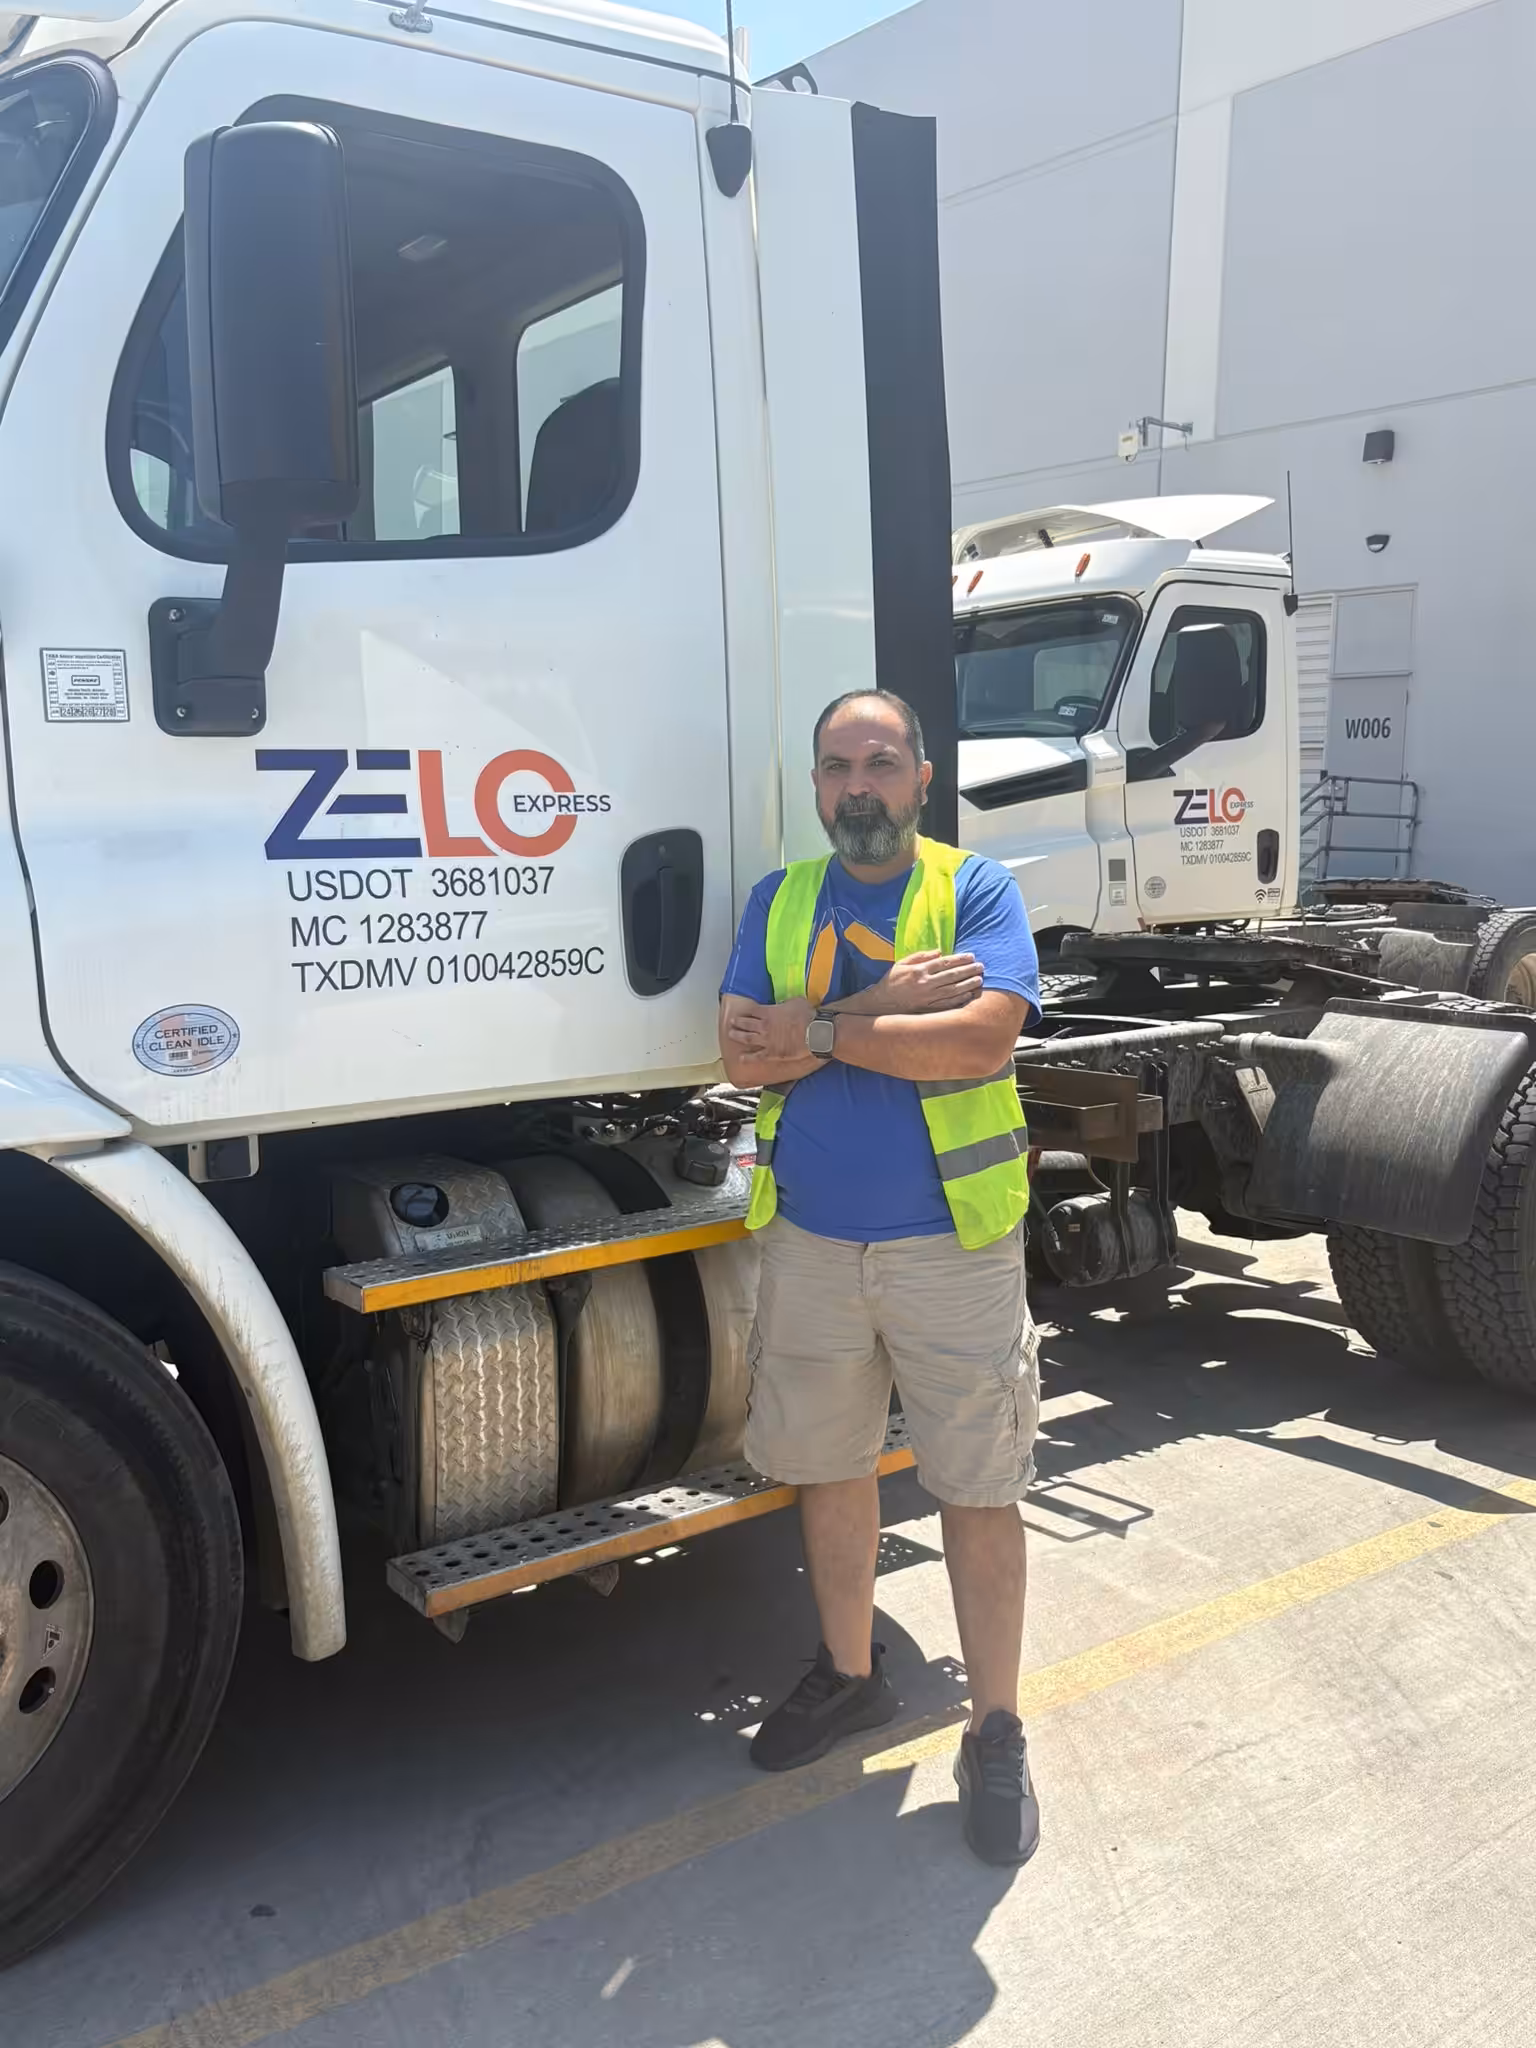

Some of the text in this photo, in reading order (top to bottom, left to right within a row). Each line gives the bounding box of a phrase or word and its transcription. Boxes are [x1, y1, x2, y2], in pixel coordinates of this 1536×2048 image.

[1345, 717, 1391, 739] W006
[513, 795, 611, 813] EXPRESS
[1230, 801, 1254, 809] EXPRESS
[1180, 825, 1240, 838] USDOT 3681037
[1180, 839, 1224, 852] MC 1283877
[1181, 852, 1252, 865] TXDMV 010042859C
[287, 866, 555, 901] USDOT 3681037
[291, 911, 488, 947] MC 1283877
[291, 947, 605, 992] TXDMV 010042859C
[154, 1024, 218, 1039] CERTIFIED
[149, 1039, 192, 1052] CLEAN
[197, 1035, 225, 1046] IDLE
